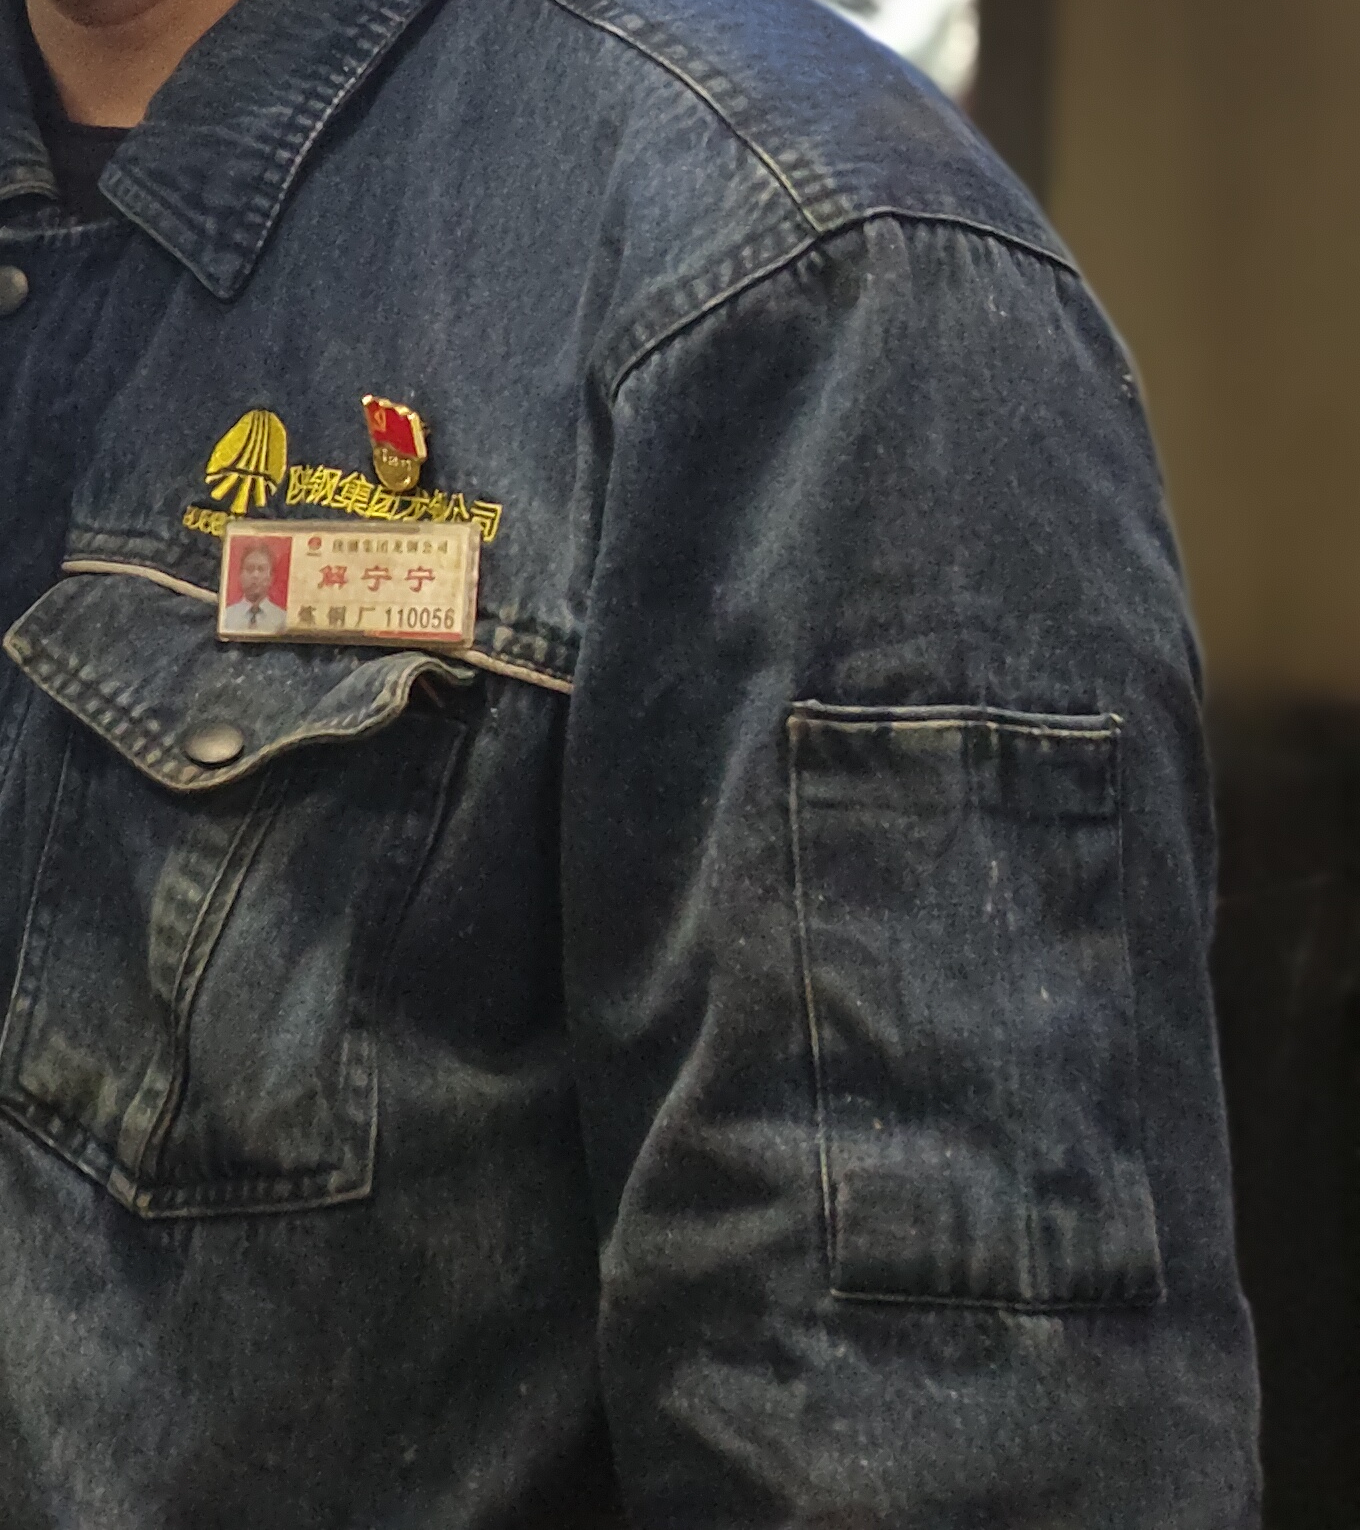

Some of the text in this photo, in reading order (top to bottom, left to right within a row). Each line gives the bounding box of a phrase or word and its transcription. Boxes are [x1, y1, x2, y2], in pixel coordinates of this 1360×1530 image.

[316, 564, 435, 592] 解宁宁
[385, 606, 455, 629] 110056
